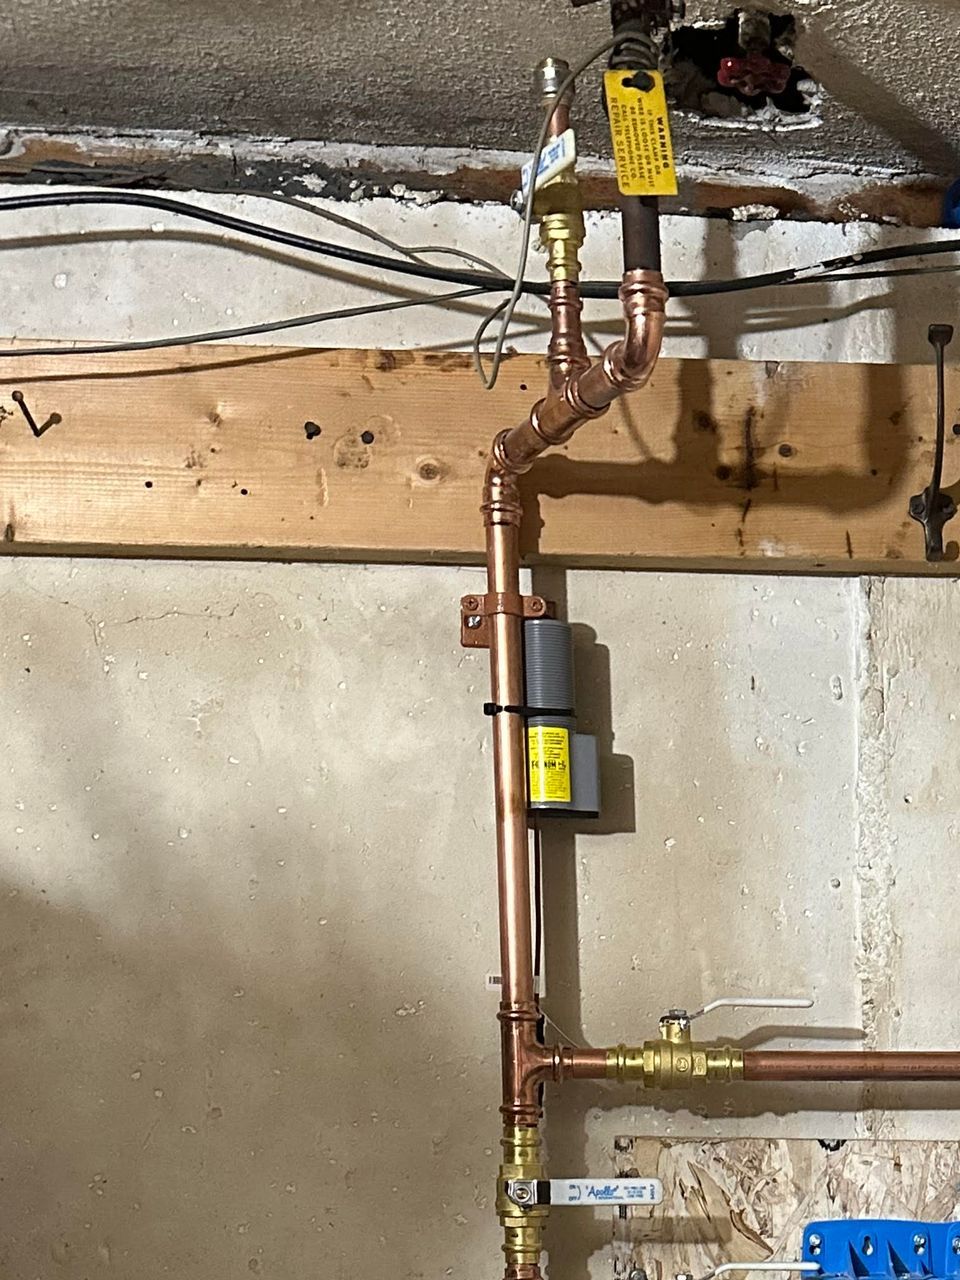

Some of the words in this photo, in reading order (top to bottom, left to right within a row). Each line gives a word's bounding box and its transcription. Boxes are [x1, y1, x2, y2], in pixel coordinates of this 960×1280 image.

[610, 97, 622, 137] REPAIR
[616, 141, 630, 188] SERVICE
[624, 124, 636, 165] TELEPHONE
[631, 118, 641, 152] REMOVED
[636, 154, 646, 180] PLEASE
[640, 128, 650, 153] LOOSE
[644, 154, 652, 165] OR
[656, 117, 670, 169] WARNING
[646, 168, 656, 188] MUST
